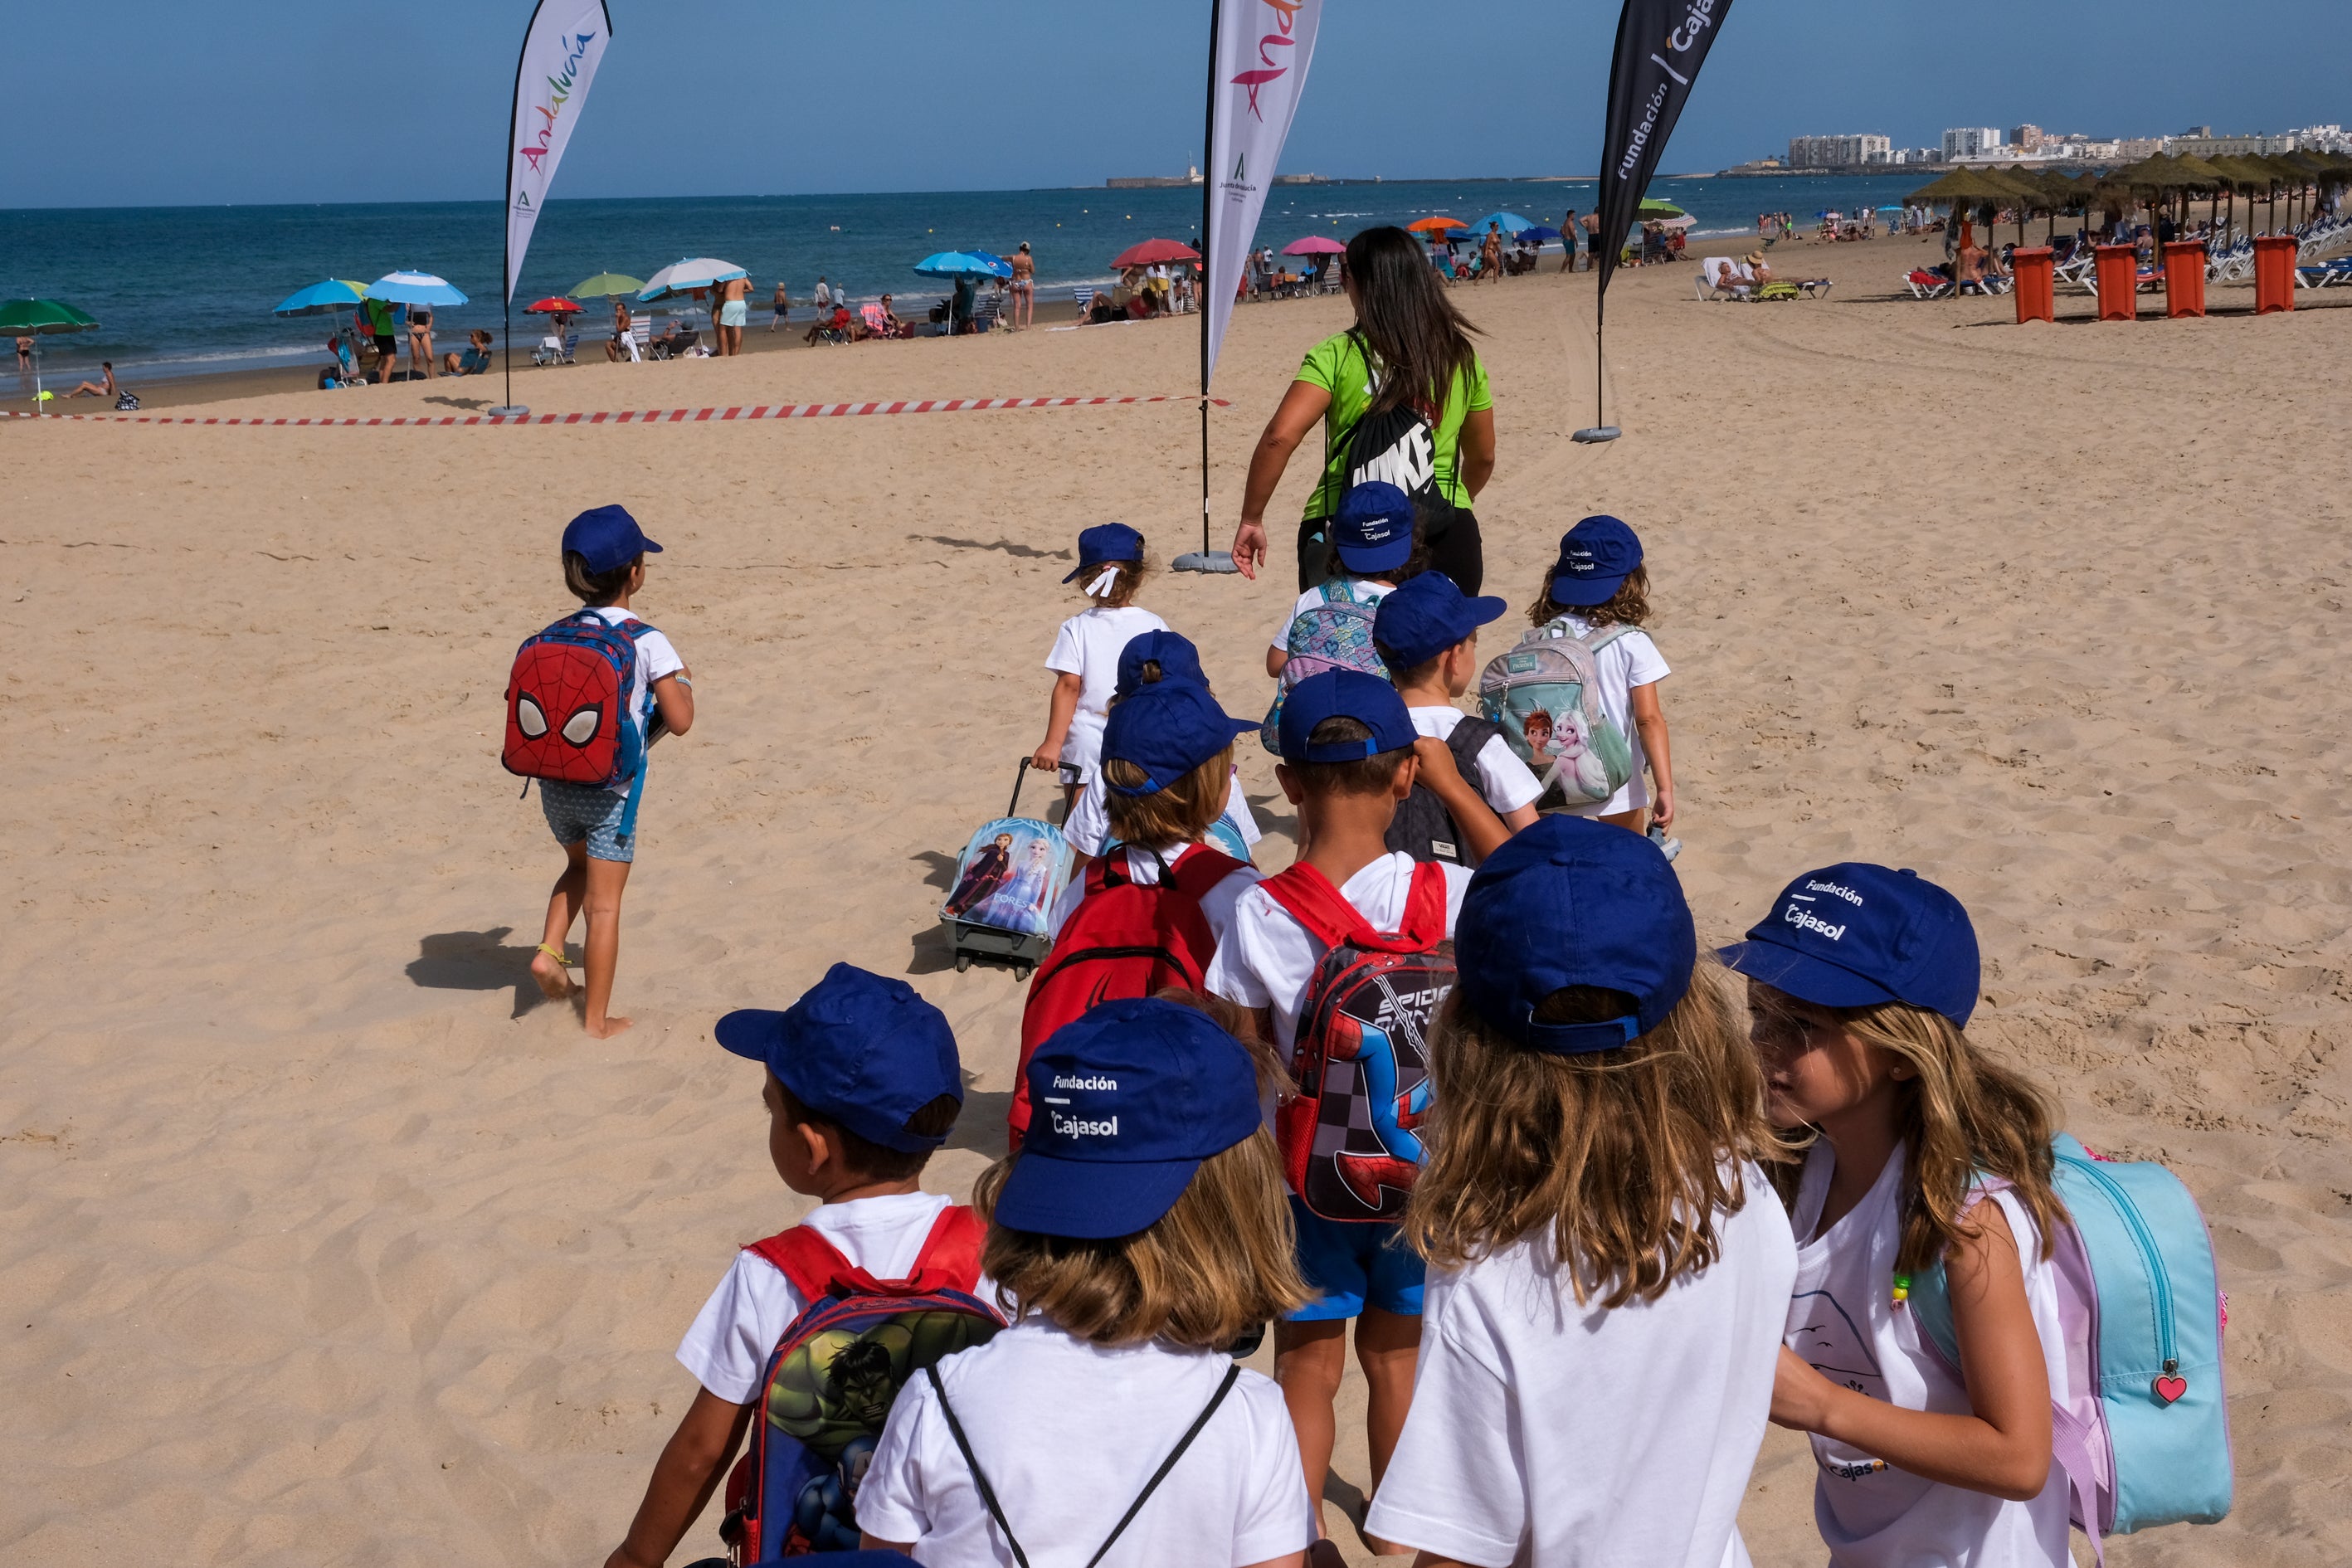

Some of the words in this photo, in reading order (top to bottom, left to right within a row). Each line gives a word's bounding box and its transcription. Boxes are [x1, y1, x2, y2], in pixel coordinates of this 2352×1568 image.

[1230, 0, 1303, 124] And
[519, 32, 597, 177] Andalucía
[1617, 82, 1668, 180] Fundación
[1361, 517, 1389, 528] Fundación
[1364, 528, 1390, 541] Cajasol
[1570, 561, 1595, 572] Cajasol
[993, 892, 1031, 910] FORES
[1805, 879, 1864, 908] Fundación
[1785, 903, 1847, 942] Cajasol
[1053, 1074, 1118, 1091] Fundación
[1050, 1109, 1118, 1141] Cajasol
